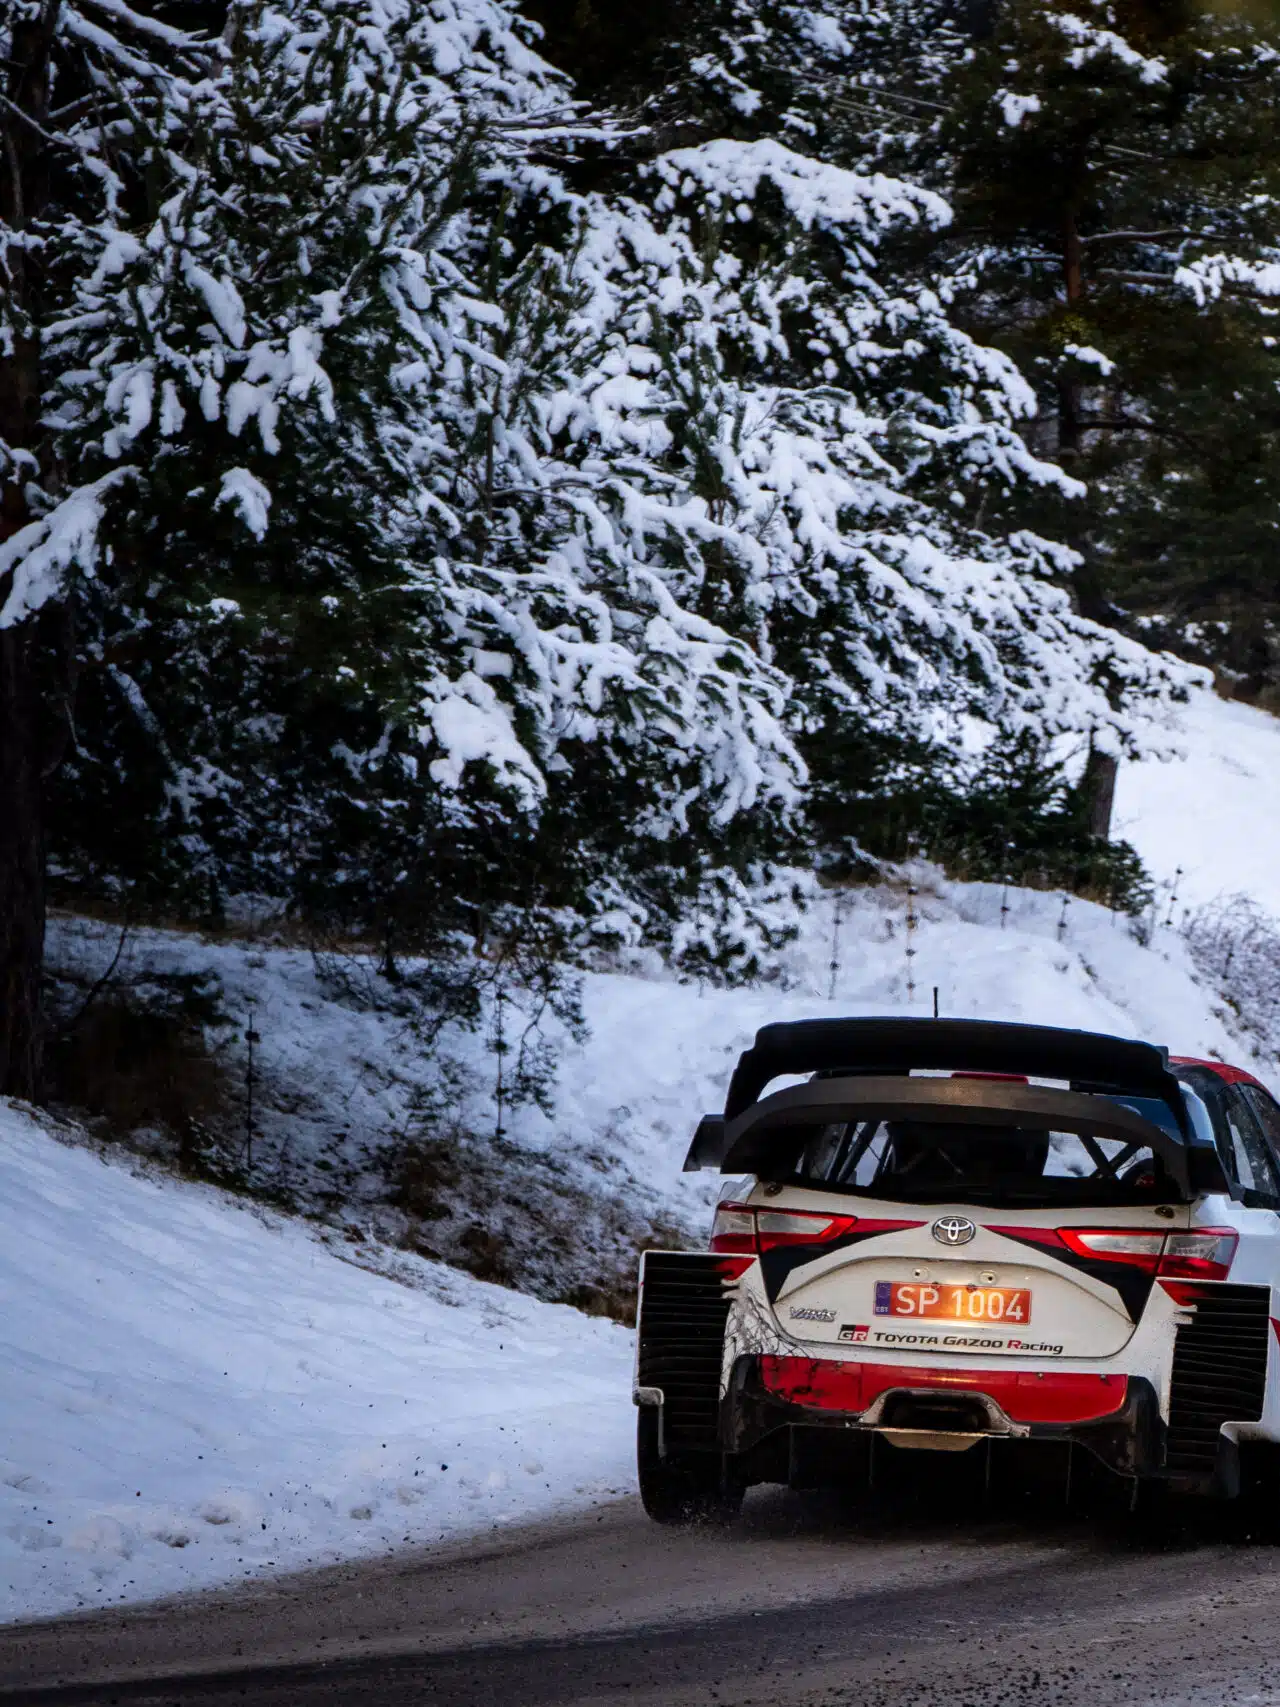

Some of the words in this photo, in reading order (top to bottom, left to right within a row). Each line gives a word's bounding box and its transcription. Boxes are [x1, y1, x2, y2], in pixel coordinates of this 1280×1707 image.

[896, 1286, 940, 1315] SP
[952, 1288, 1024, 1321] 1004
[838, 1330, 868, 1341] GR
[874, 1332, 939, 1345] TOYOTA
[942, 1336, 1004, 1349] GAZOO
[1007, 1339, 1064, 1355] Racing
